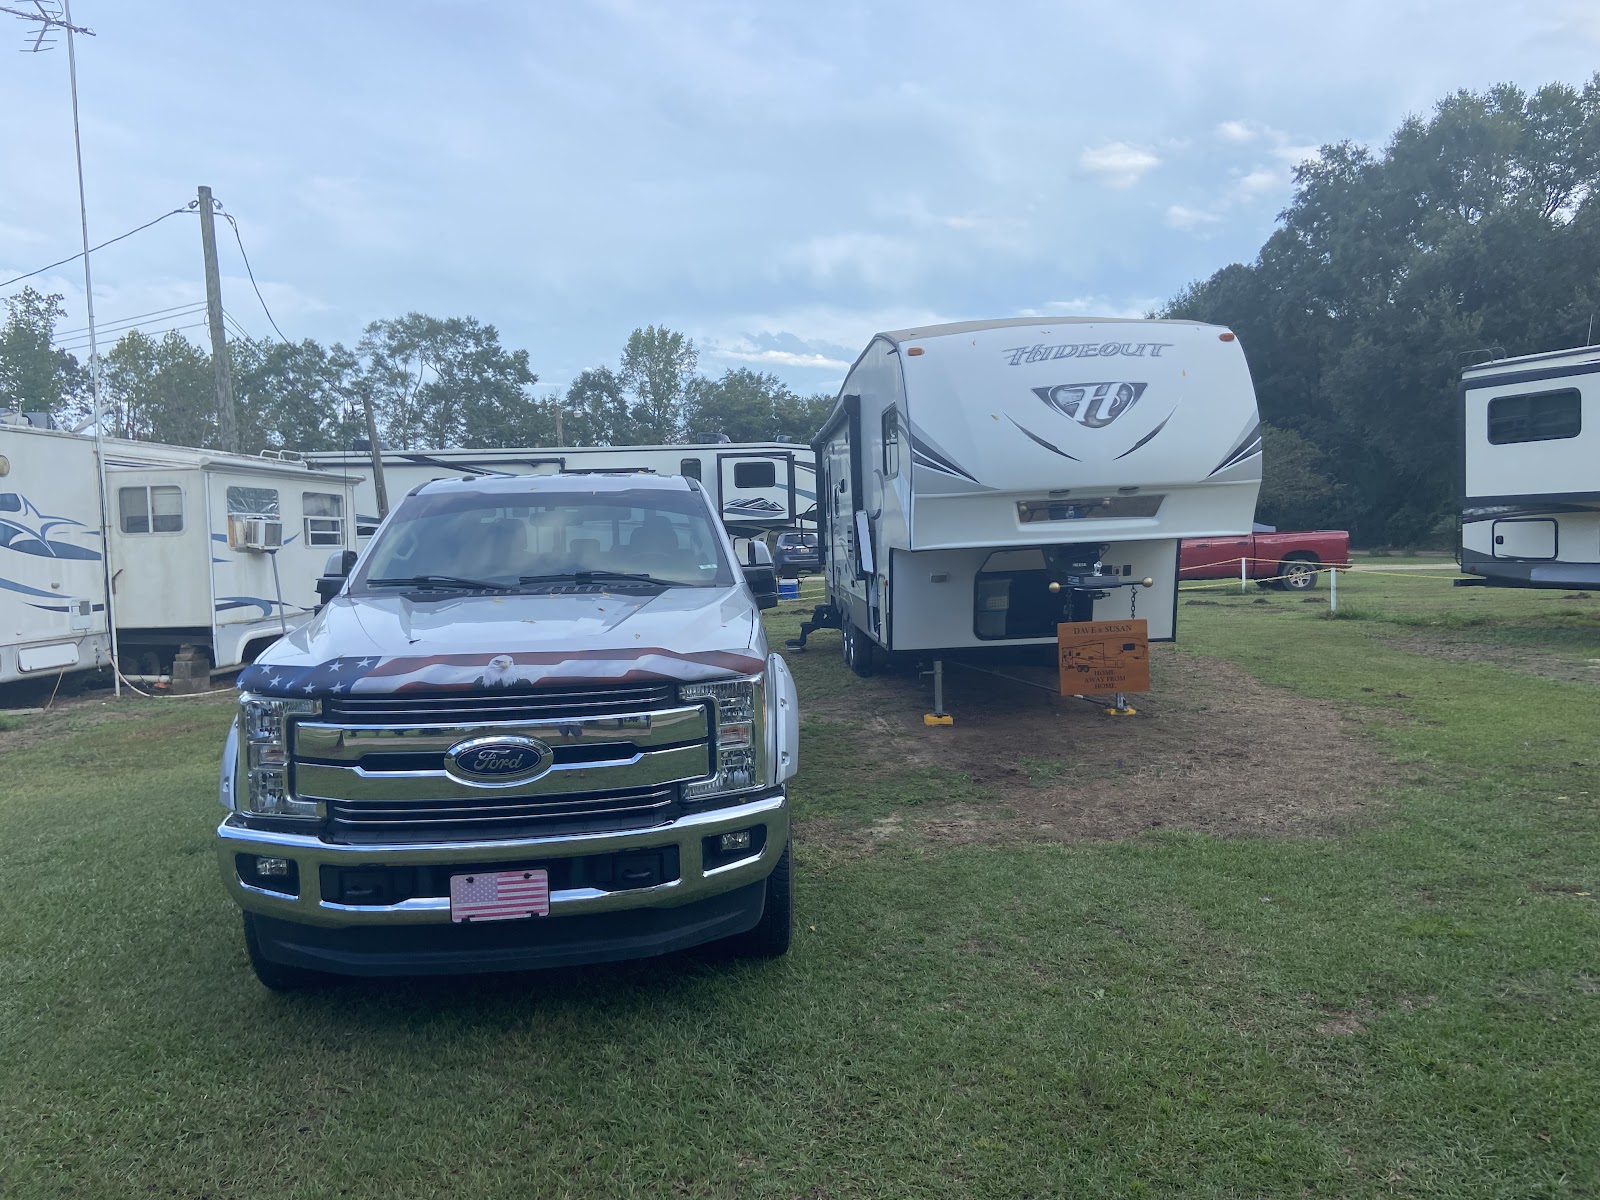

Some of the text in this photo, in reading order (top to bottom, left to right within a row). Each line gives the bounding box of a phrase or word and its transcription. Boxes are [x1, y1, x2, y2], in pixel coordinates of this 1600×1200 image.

[1002, 342, 1174, 366] HIDEOUT
[1073, 626, 1097, 635] DAVE
[1104, 624, 1133, 633] SUSAN
[473, 749, 523, 771] Ford
